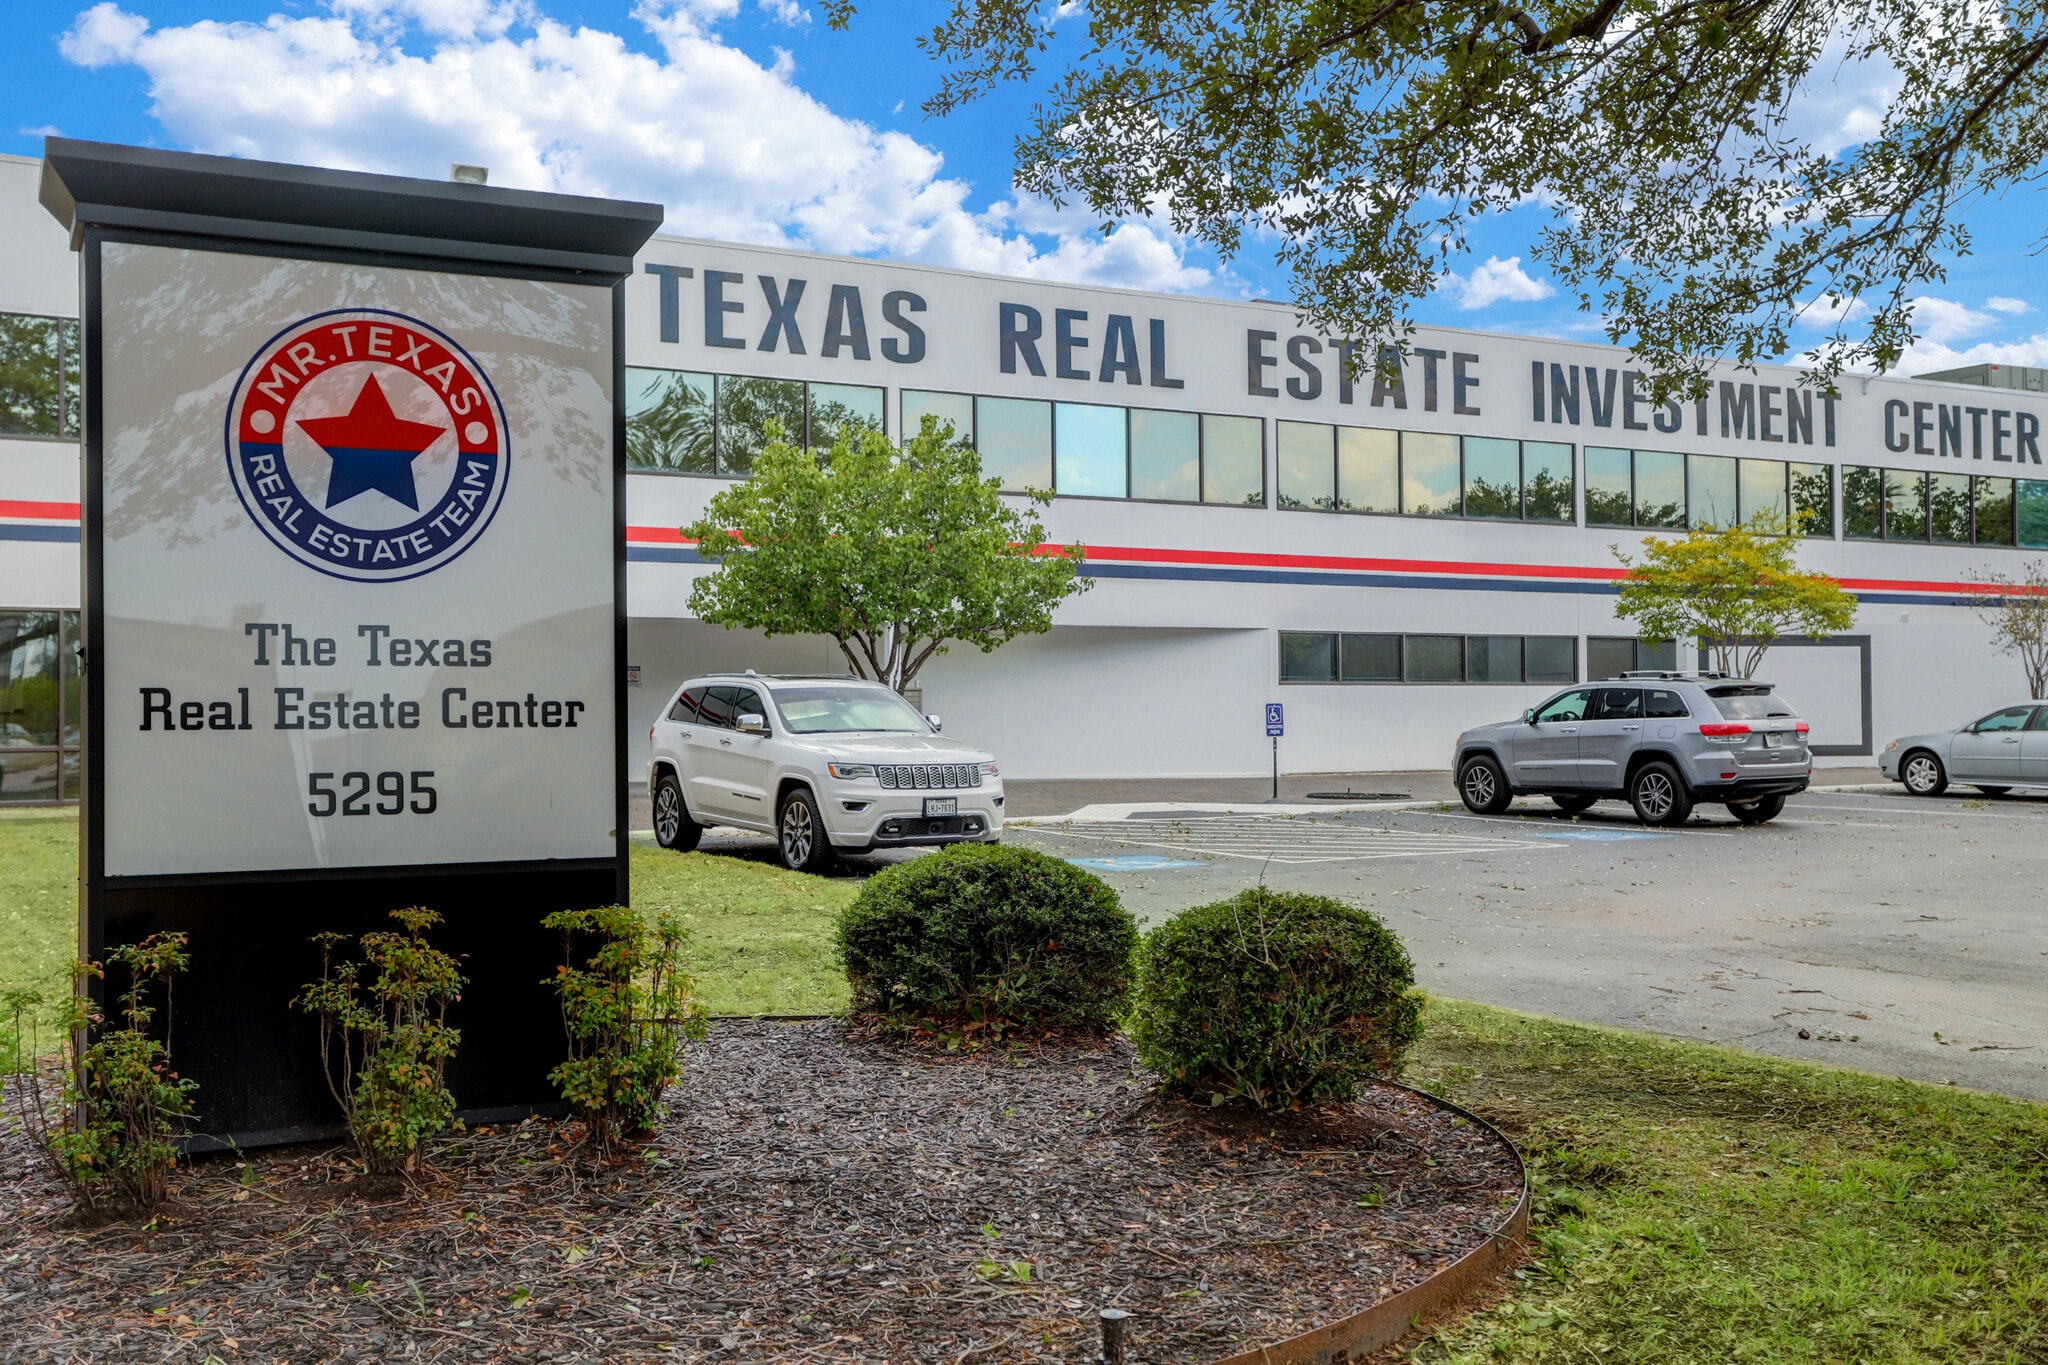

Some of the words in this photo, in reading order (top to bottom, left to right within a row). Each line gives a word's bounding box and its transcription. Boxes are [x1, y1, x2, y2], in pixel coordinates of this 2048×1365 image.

[332, 326, 482, 416] TEXAS
[645, 263, 927, 364] TEXAS
[999, 302, 1184, 389] REAL
[1247, 329, 1481, 416] ESTATE
[1532, 361, 1842, 447] INVESTMENT
[1884, 399, 2042, 465] CENTER
[250, 454, 304, 534] REAL
[307, 523, 434, 563] ESTATE
[428, 460, 490, 538] TEAM
[244, 623, 336, 667] The
[358, 625, 492, 667] Texas
[139, 688, 252, 731] Real
[274, 688, 420, 730] Estate
[441, 688, 585, 728] Center
[308, 771, 438, 817] 5295
